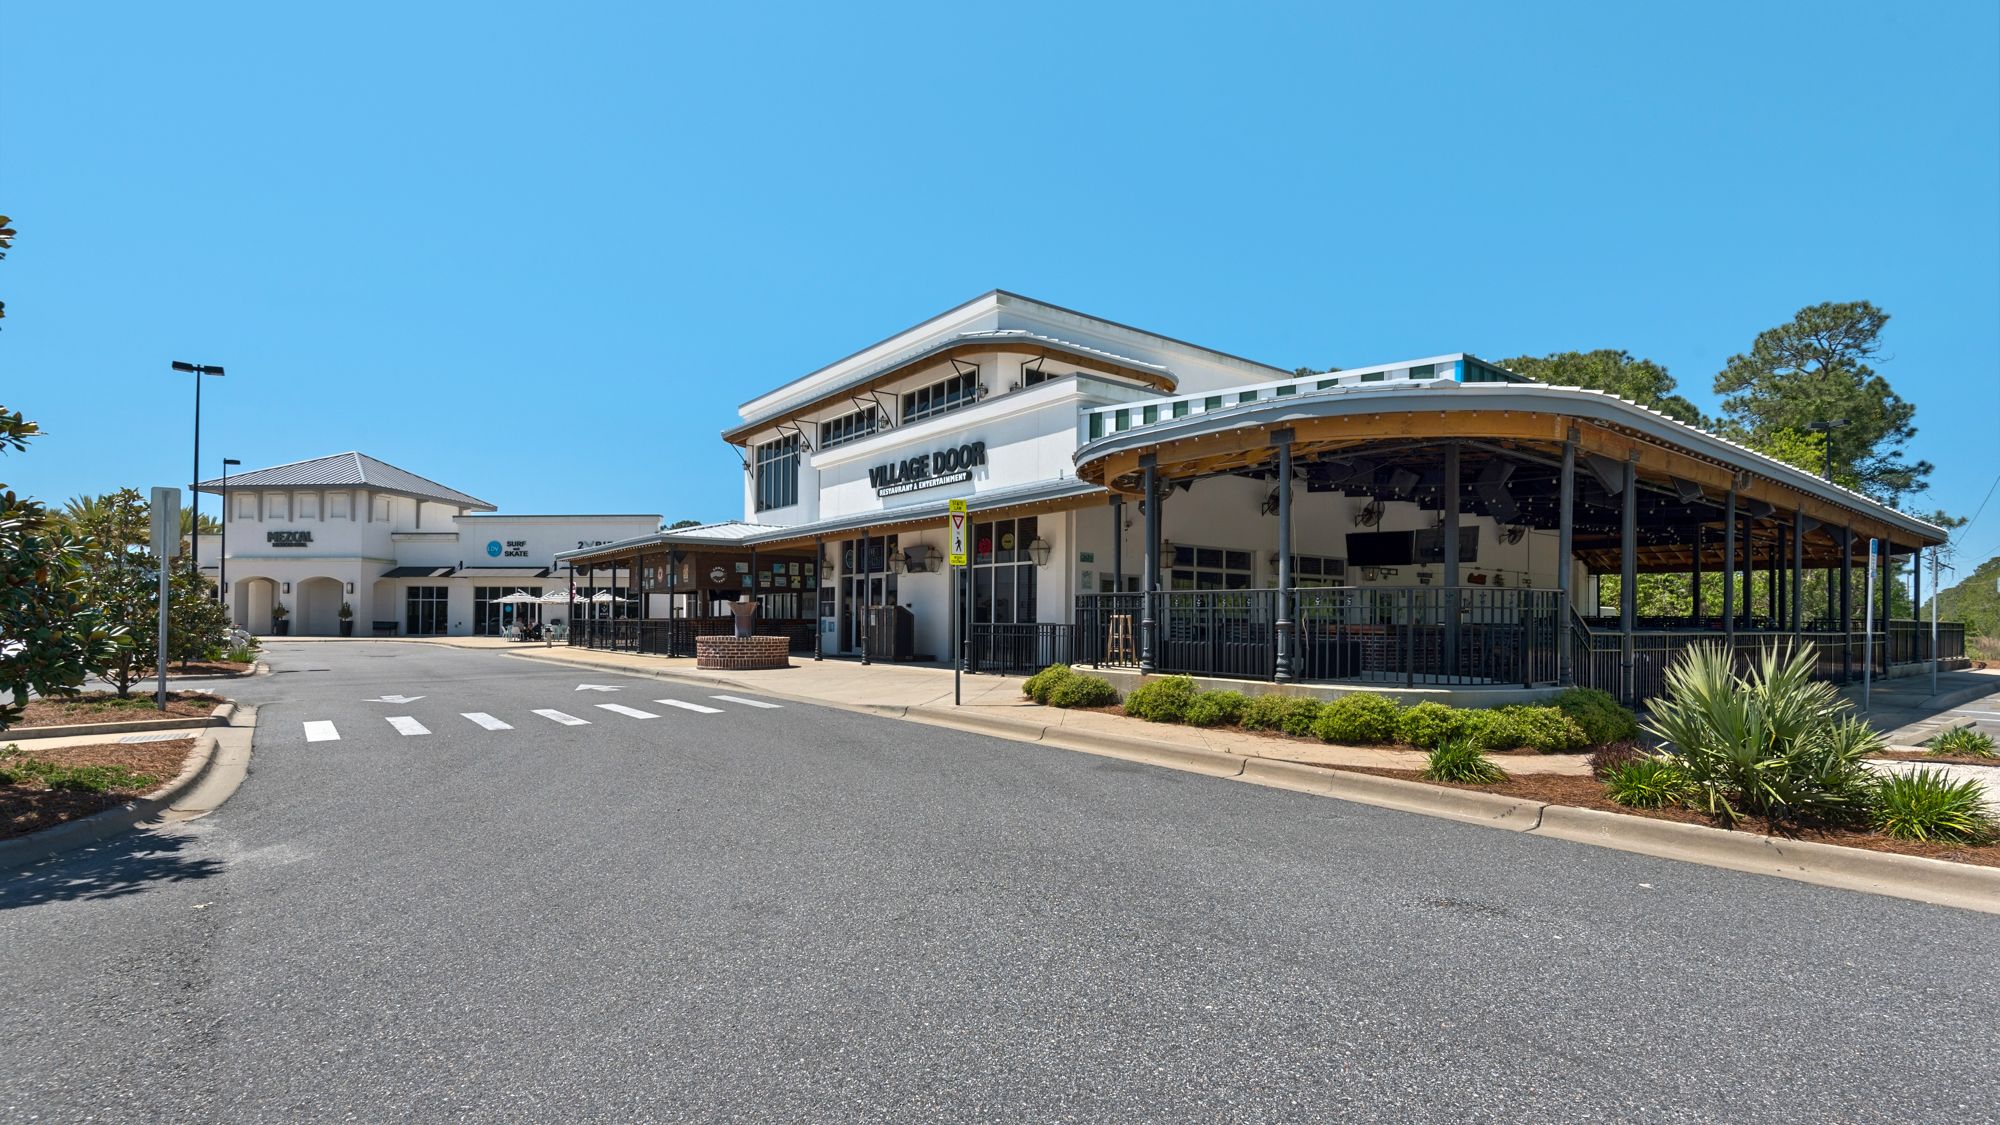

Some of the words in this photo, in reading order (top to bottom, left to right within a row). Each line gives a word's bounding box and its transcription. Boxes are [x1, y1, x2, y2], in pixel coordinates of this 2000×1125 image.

[869, 455, 930, 488] VILLAGE
[932, 441, 985, 475] DOOR
[880, 485, 913, 496] RESTAURANT
[919, 472, 967, 489] ENTERTAINMENT
[267, 531, 314, 542] MEZCAL
